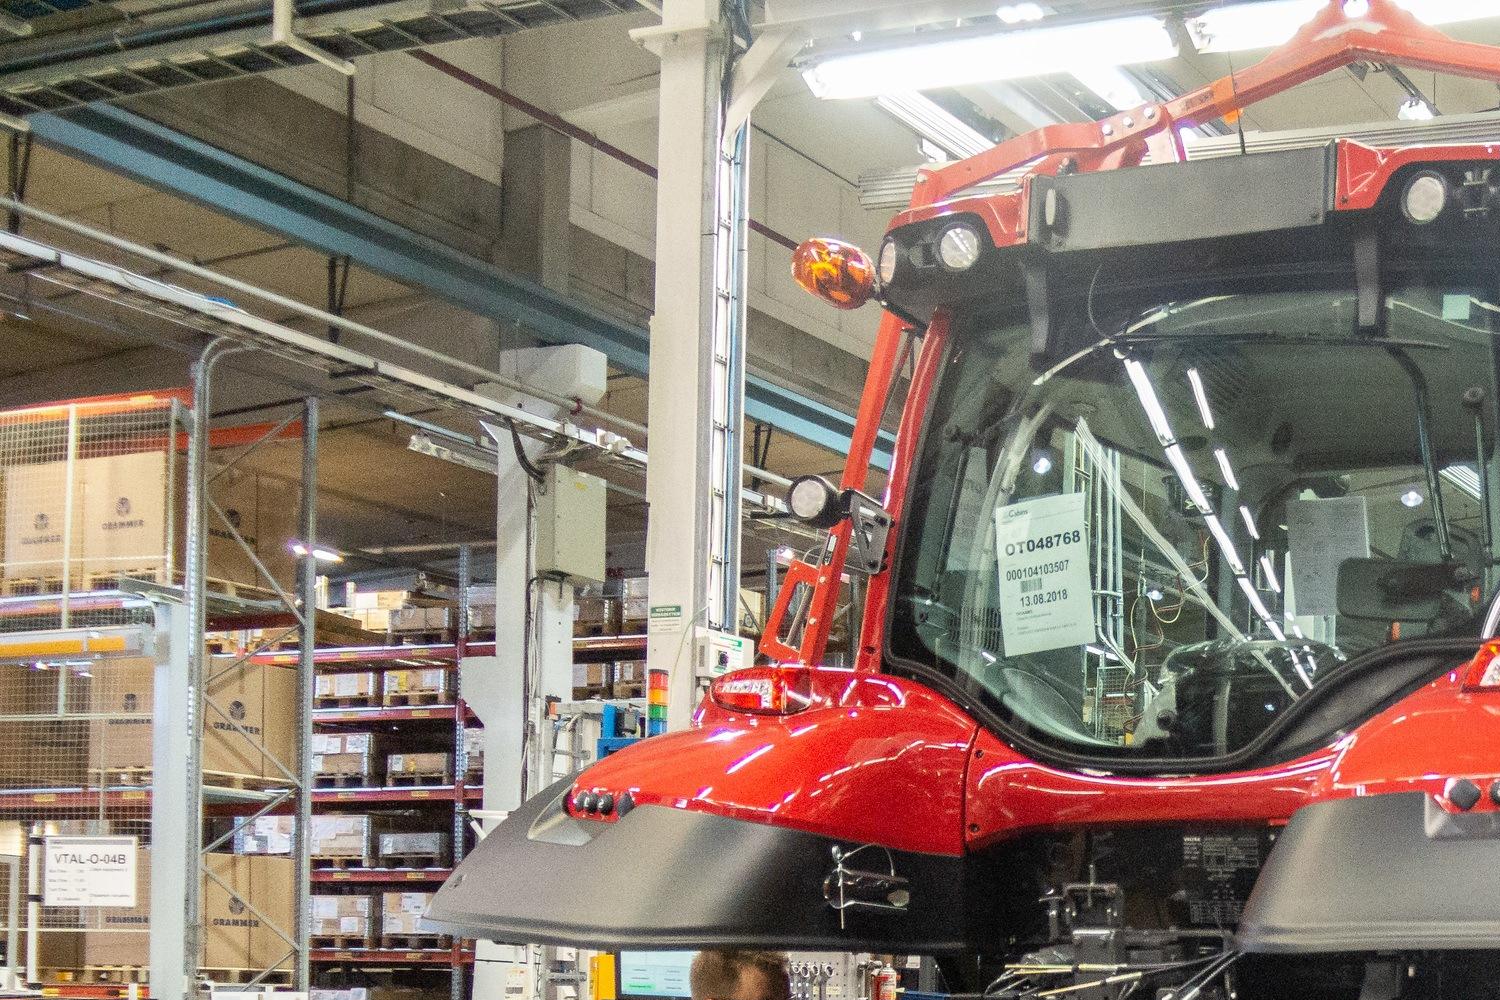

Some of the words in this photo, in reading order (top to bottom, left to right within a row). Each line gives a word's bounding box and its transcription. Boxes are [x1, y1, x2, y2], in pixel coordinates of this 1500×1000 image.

[1005, 530, 1081, 556] OT048768
[1006, 559, 1070, 581] 000104103507
[1020, 588, 1068, 607] 13.08.2018
[54, 854, 126, 864] VTAL-O-04B
